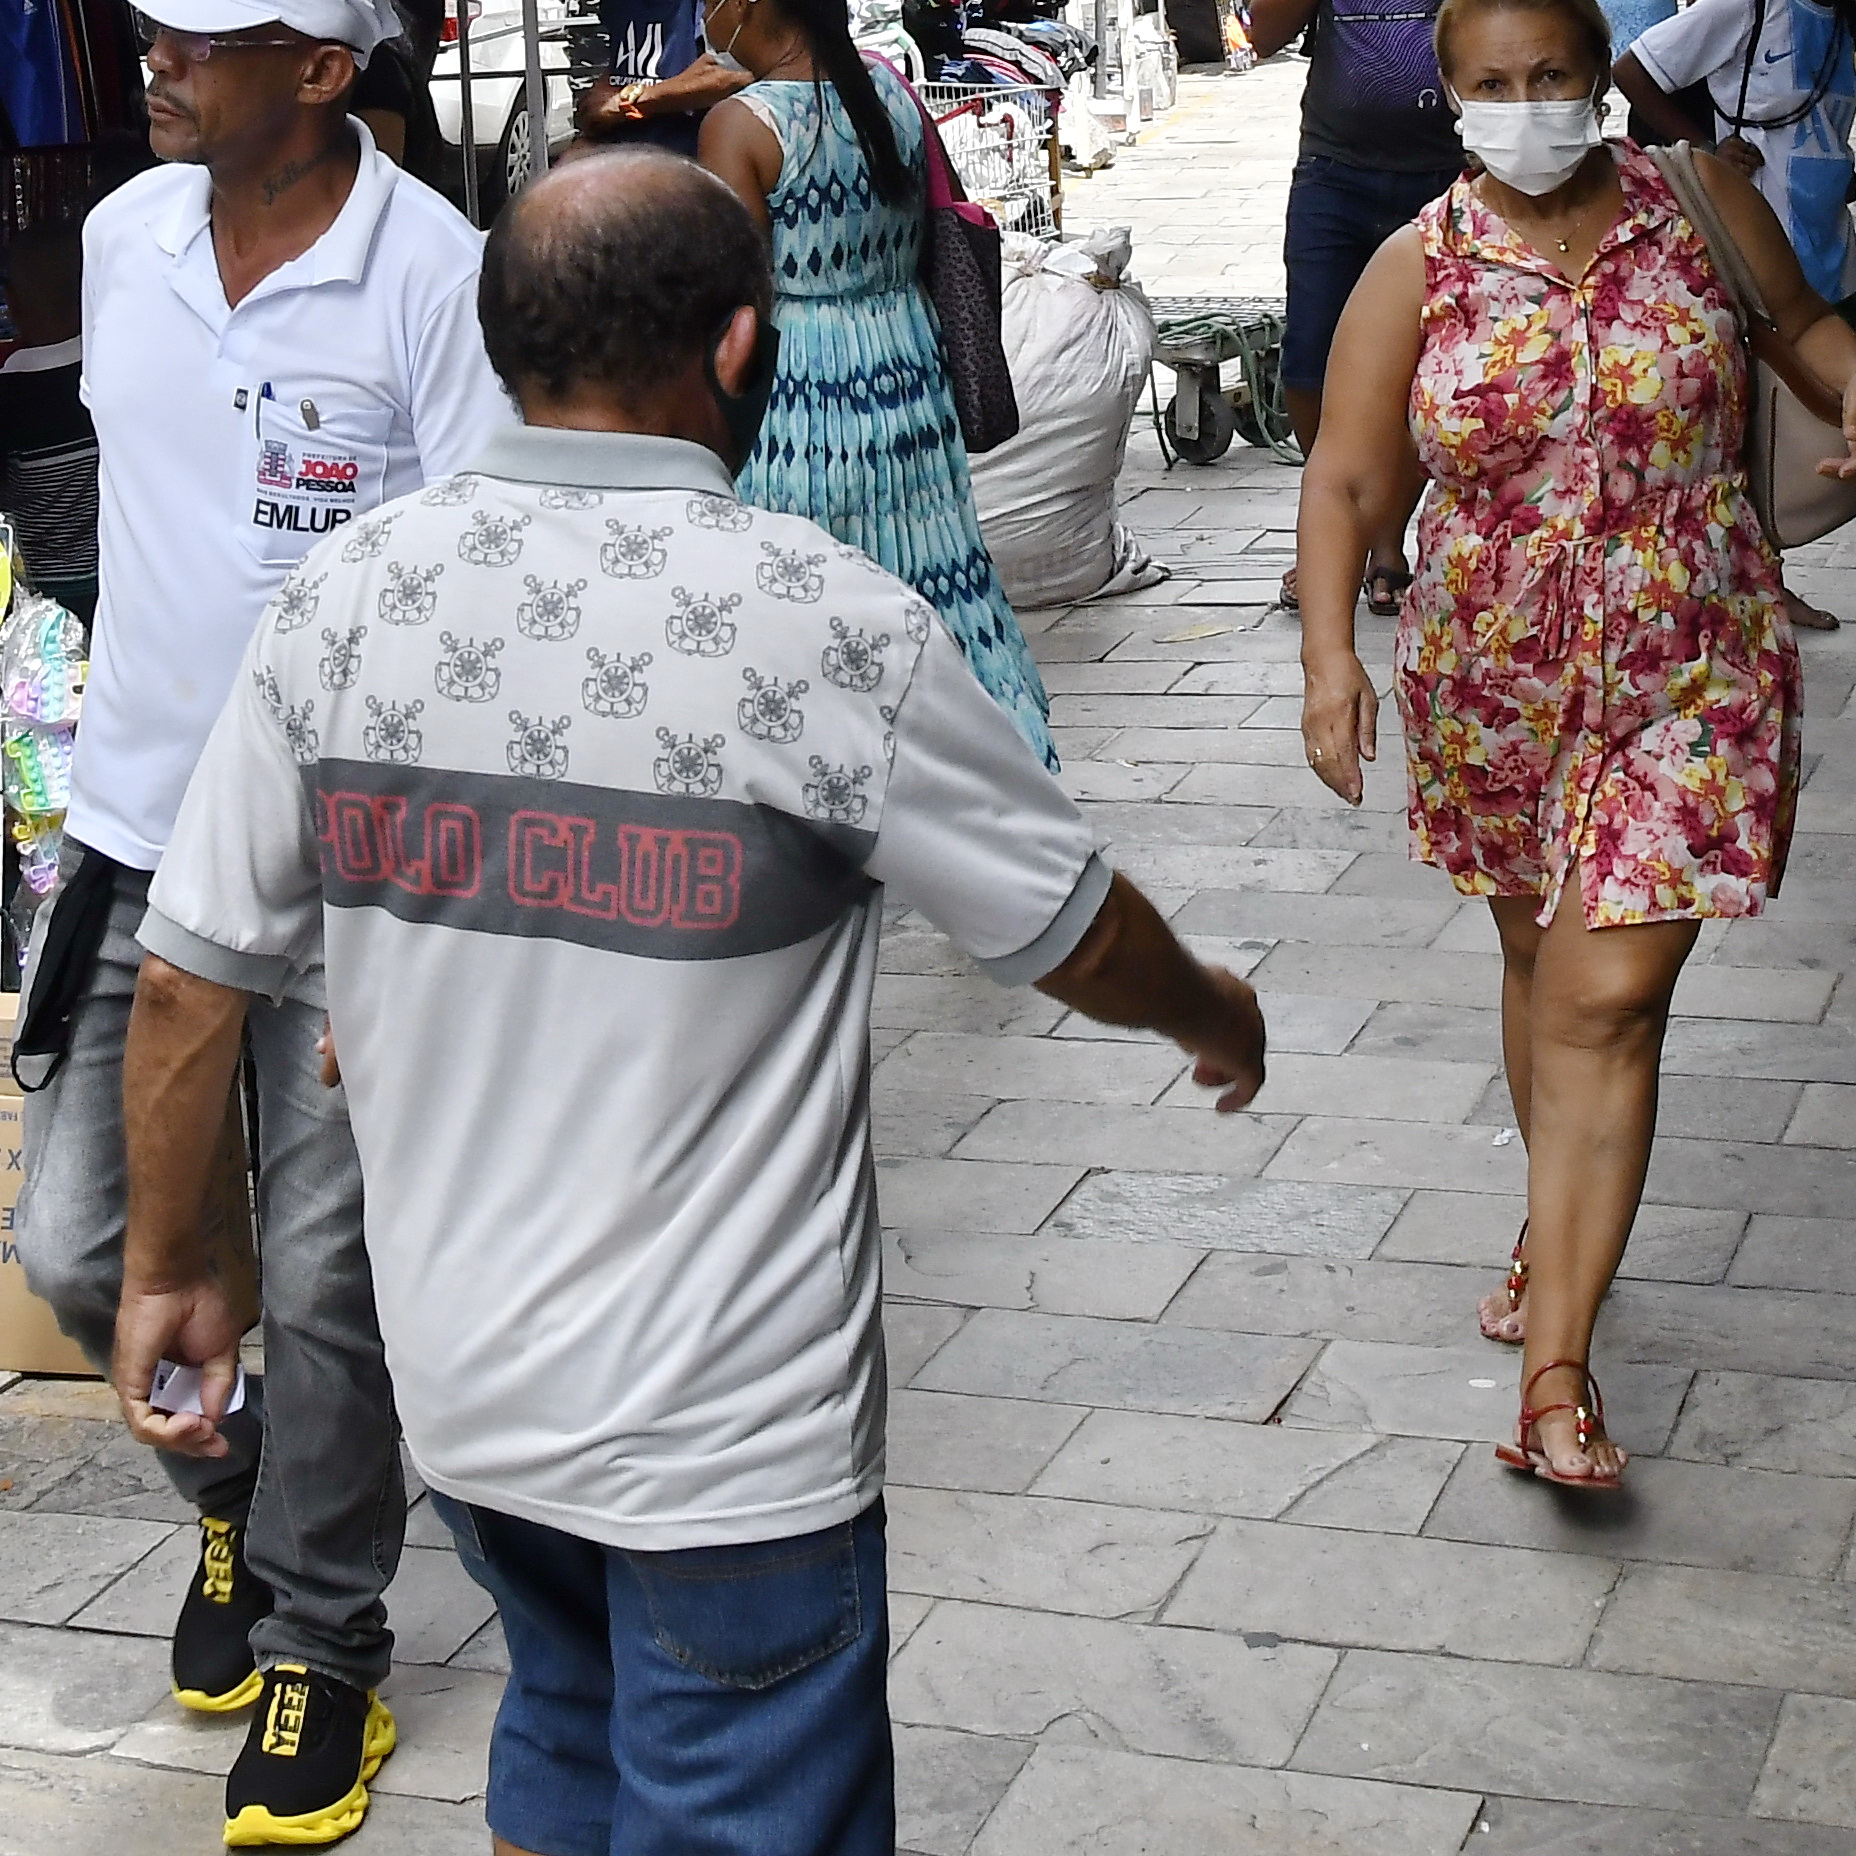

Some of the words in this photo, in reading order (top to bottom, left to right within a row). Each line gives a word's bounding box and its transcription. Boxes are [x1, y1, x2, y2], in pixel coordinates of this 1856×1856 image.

[295, 478, 357, 494] PESSOA
[508, 809, 743, 930] CLUB
[7, 1148, 23, 1171] X
[0, 1207, 16, 1231] E
